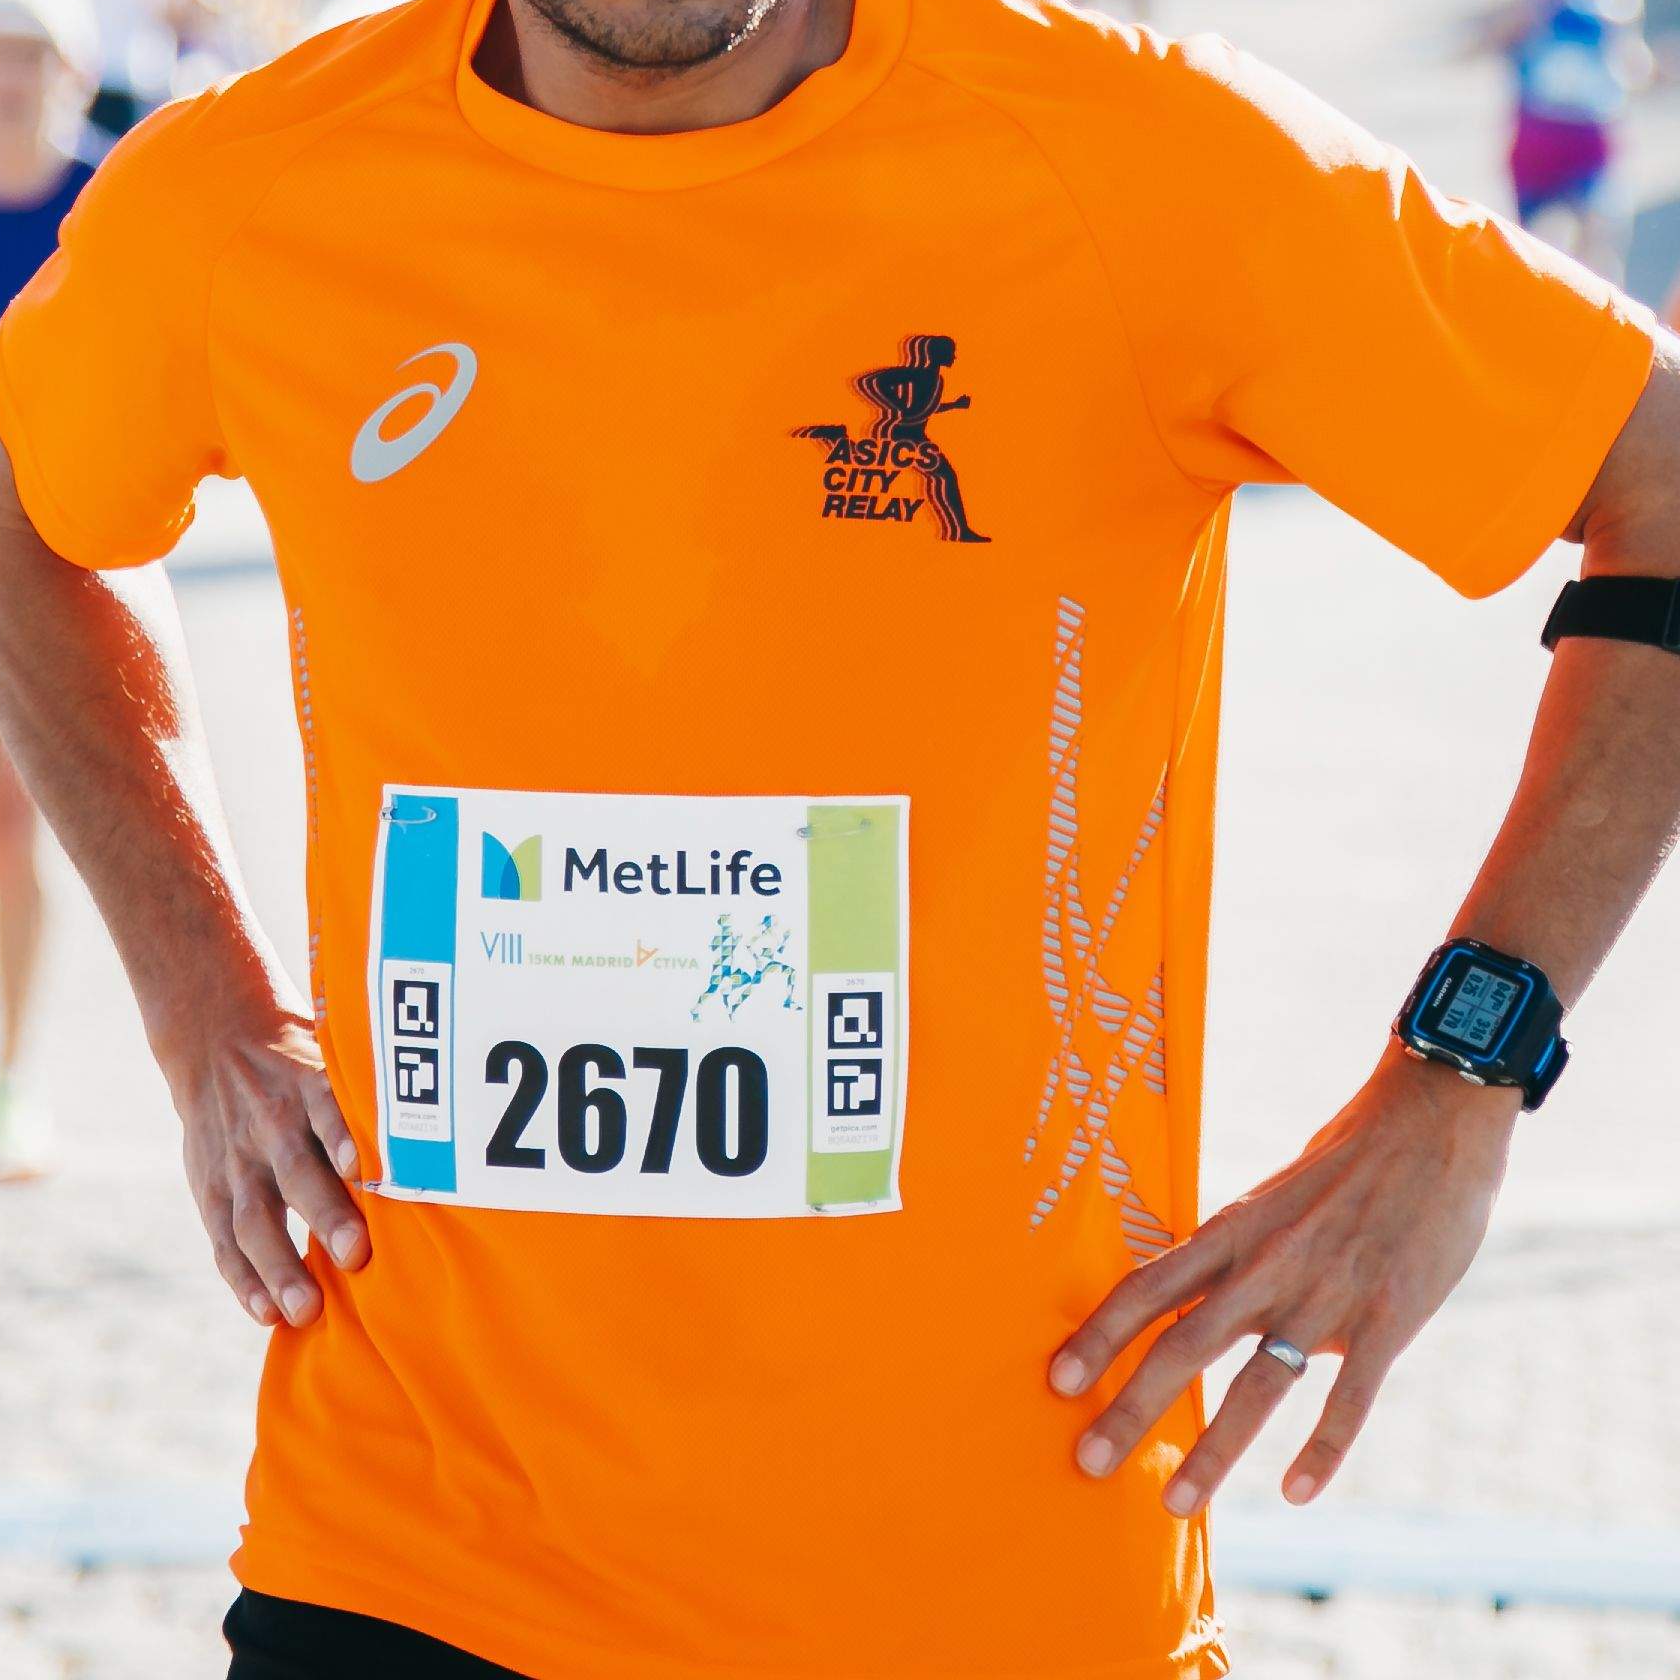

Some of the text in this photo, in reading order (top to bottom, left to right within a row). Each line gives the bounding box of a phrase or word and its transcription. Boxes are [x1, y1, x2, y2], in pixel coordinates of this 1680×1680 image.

[825, 438, 940, 469] ASICS
[823, 467, 901, 493] CITY
[822, 494, 924, 522] RELAY
[563, 846, 783, 898] MetLife
[480, 931, 523, 965] VIII
[528, 953, 566, 967] 15KM
[571, 956, 633, 969] MADRID
[1432, 977, 1452, 1008] GARMIN
[484, 1039, 770, 1178] 2670
